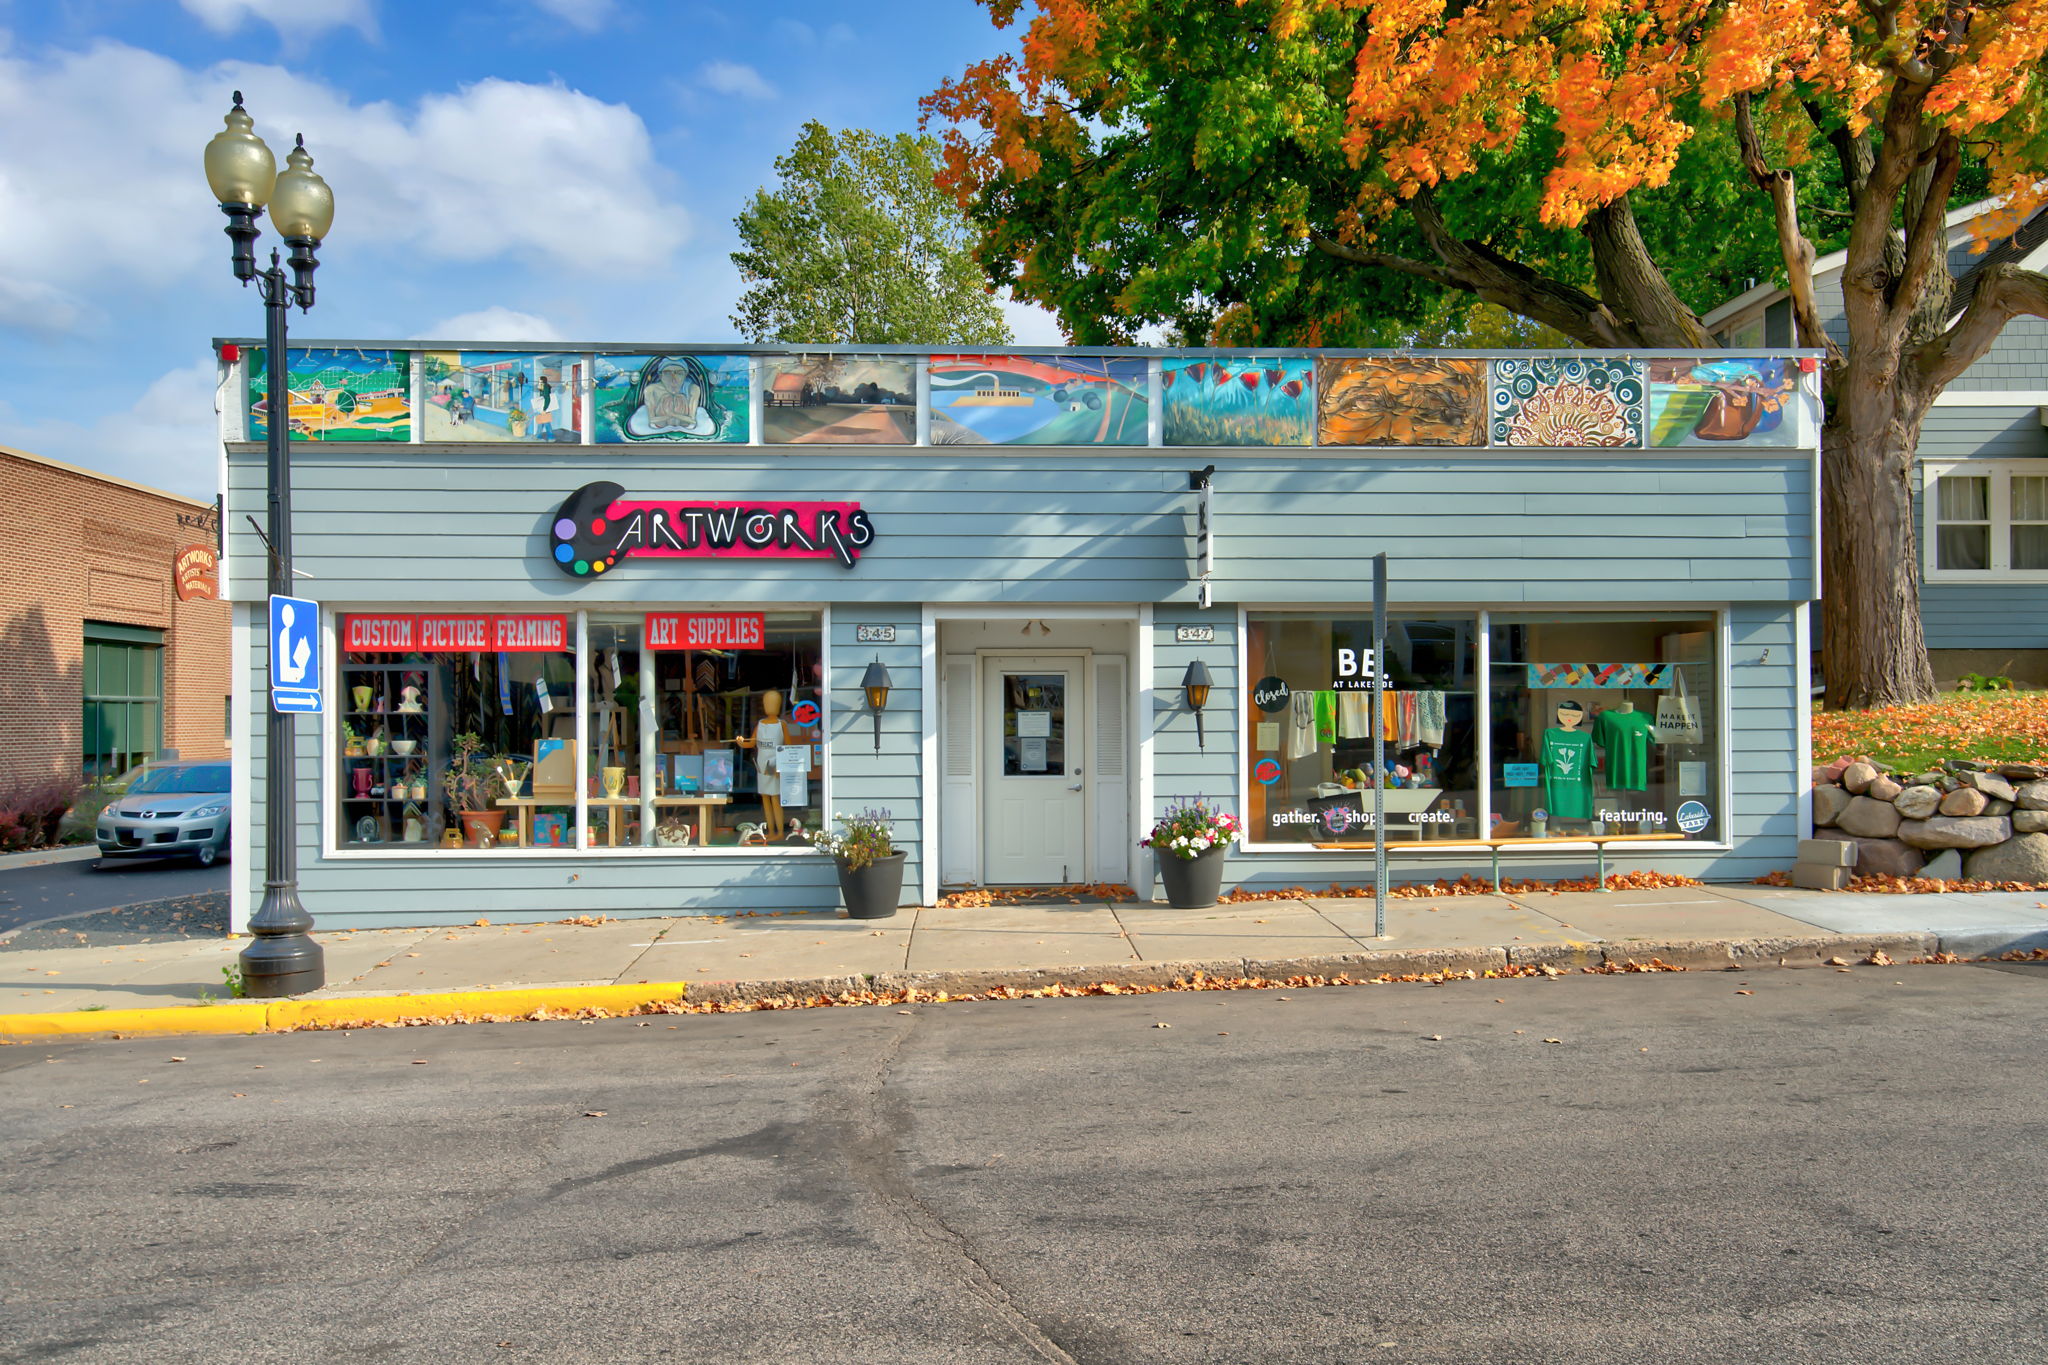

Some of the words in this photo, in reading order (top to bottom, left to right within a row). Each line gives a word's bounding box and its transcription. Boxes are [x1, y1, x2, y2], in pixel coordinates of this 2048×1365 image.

[617, 506, 869, 564] ARTWORKS
[178, 550, 213, 575] ARTWORKS
[351, 619, 412, 647] CUSTOM
[422, 619, 486, 647] PICTURE
[497, 619, 562, 647] FRAMING
[650, 618, 679, 645] ART
[688, 617, 760, 644] SUPPLIES
[1333, 681, 1344, 689] AT
[1348, 681, 1394, 689] LAKESDE
[1660, 713, 1685, 721] MAKE
[1660, 721, 1699, 730] HAPPEN
[1272, 810, 1321, 827] gather.
[1408, 811, 1455, 823] create.
[1599, 808, 1668, 824] featuring.
[1682, 819, 1704, 828] YARN
